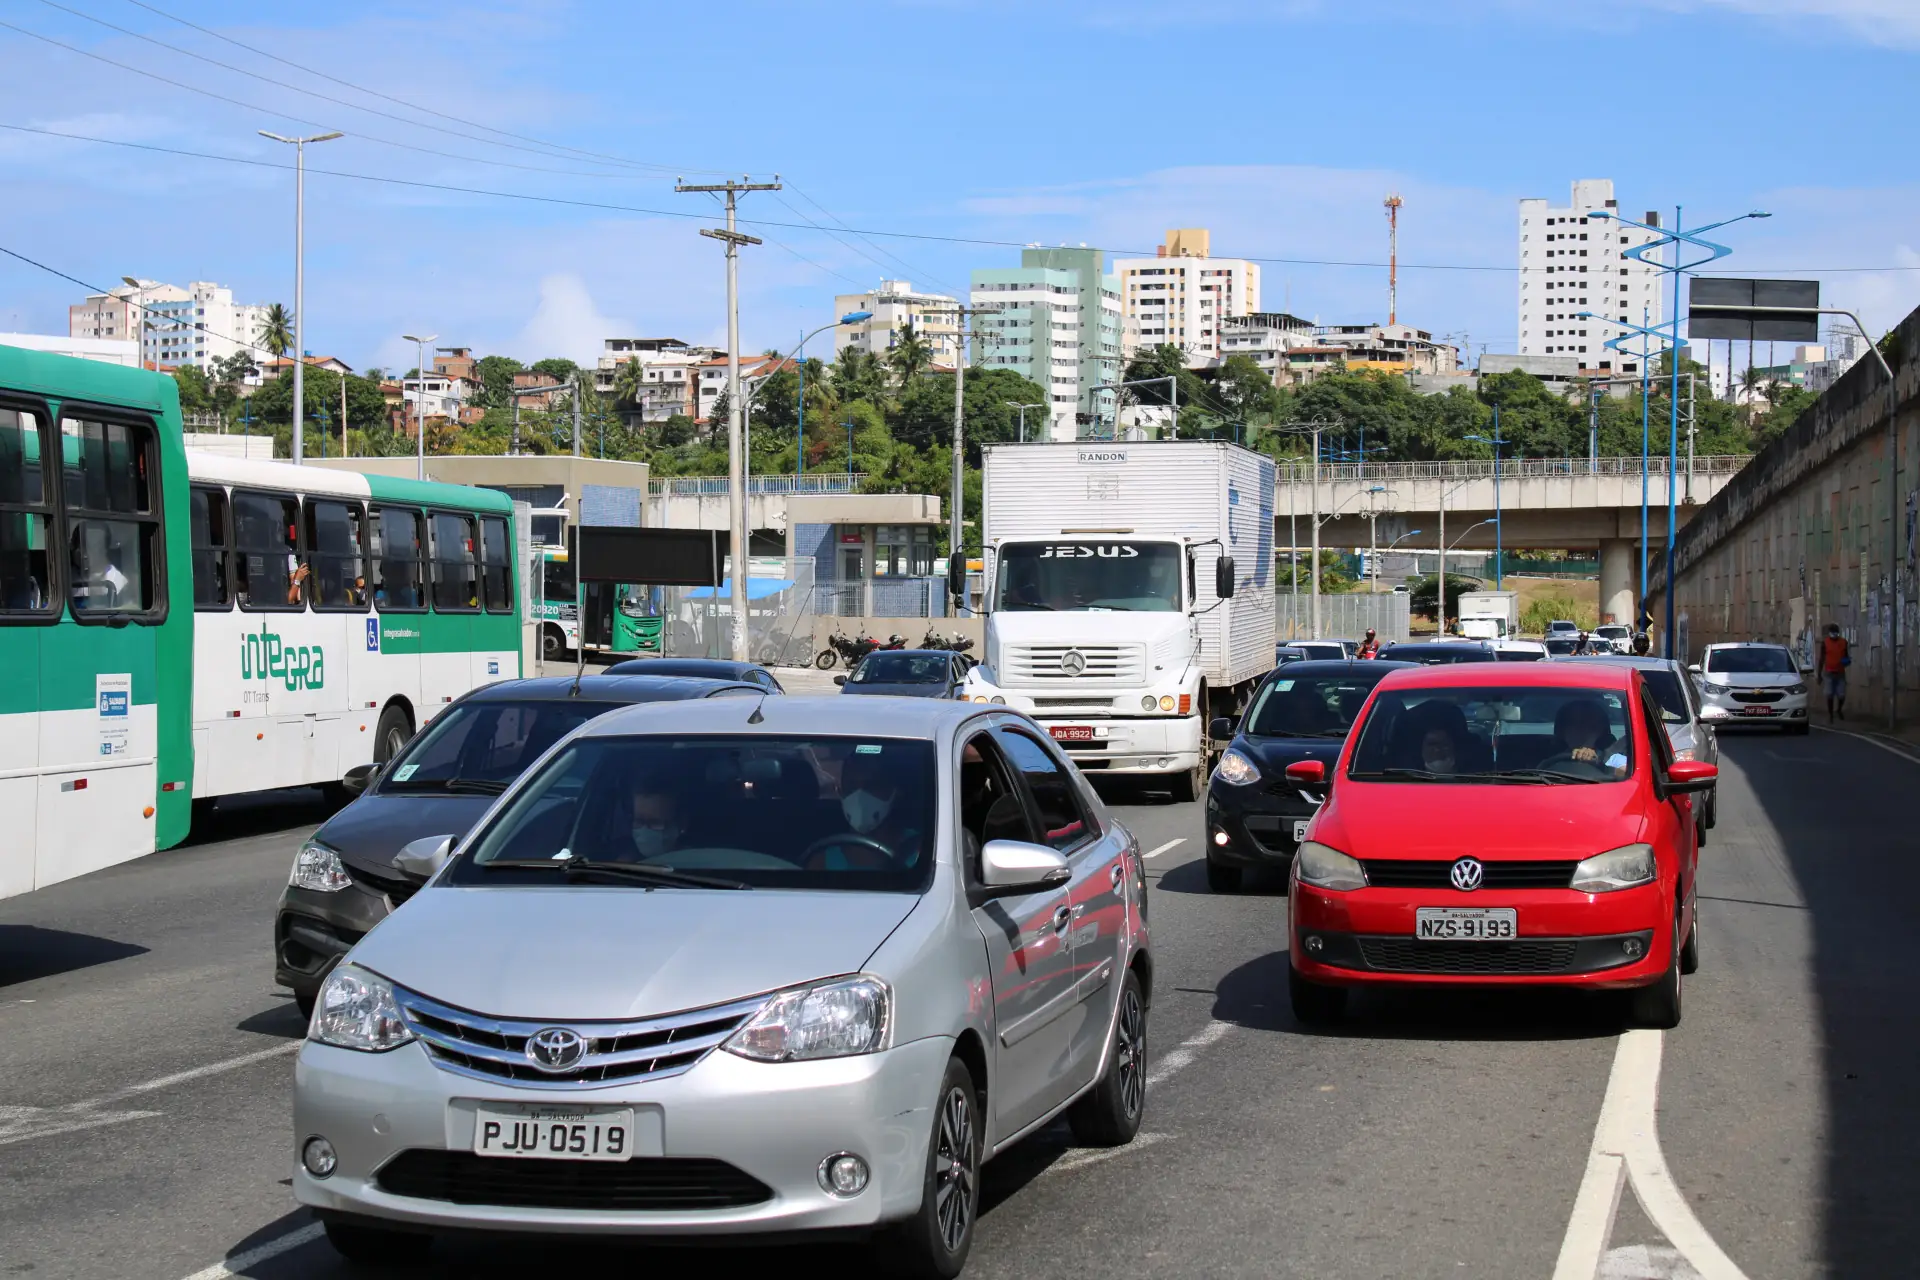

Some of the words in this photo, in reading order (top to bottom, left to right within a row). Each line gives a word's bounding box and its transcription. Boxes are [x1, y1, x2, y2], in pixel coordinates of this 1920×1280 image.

[1080, 453, 1126, 461] RANDON
[1040, 546, 1139, 558] JESUS
[243, 691, 252, 703] OT
[253, 691, 270, 703] Trans
